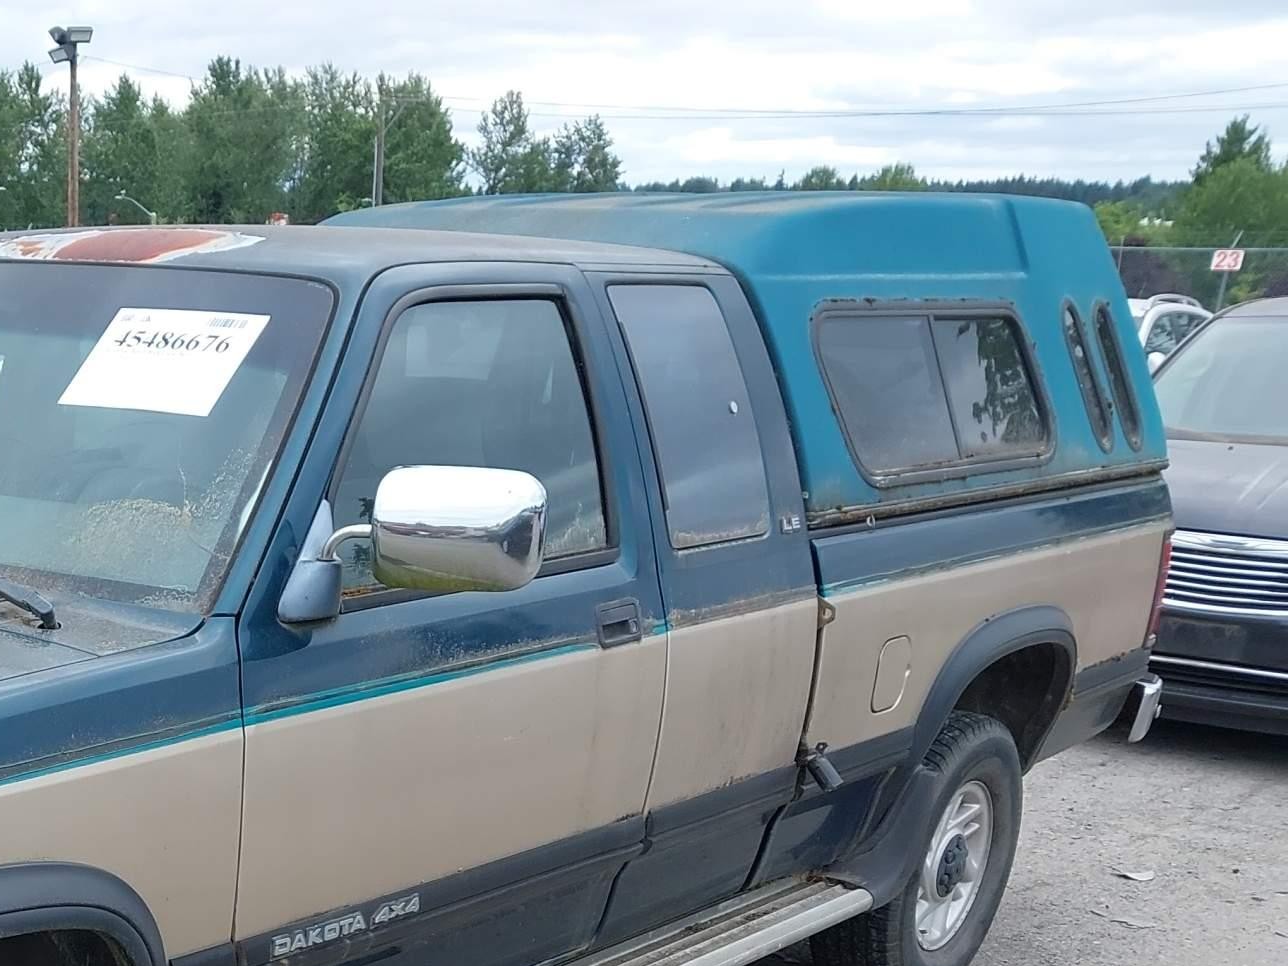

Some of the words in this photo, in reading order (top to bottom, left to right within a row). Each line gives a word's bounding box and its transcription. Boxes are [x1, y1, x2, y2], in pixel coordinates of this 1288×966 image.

[1214, 251, 1241, 269] 23
[114, 329, 234, 354] 45486676
[781, 516, 801, 532] LE
[272, 913, 367, 958] DAKOTA
